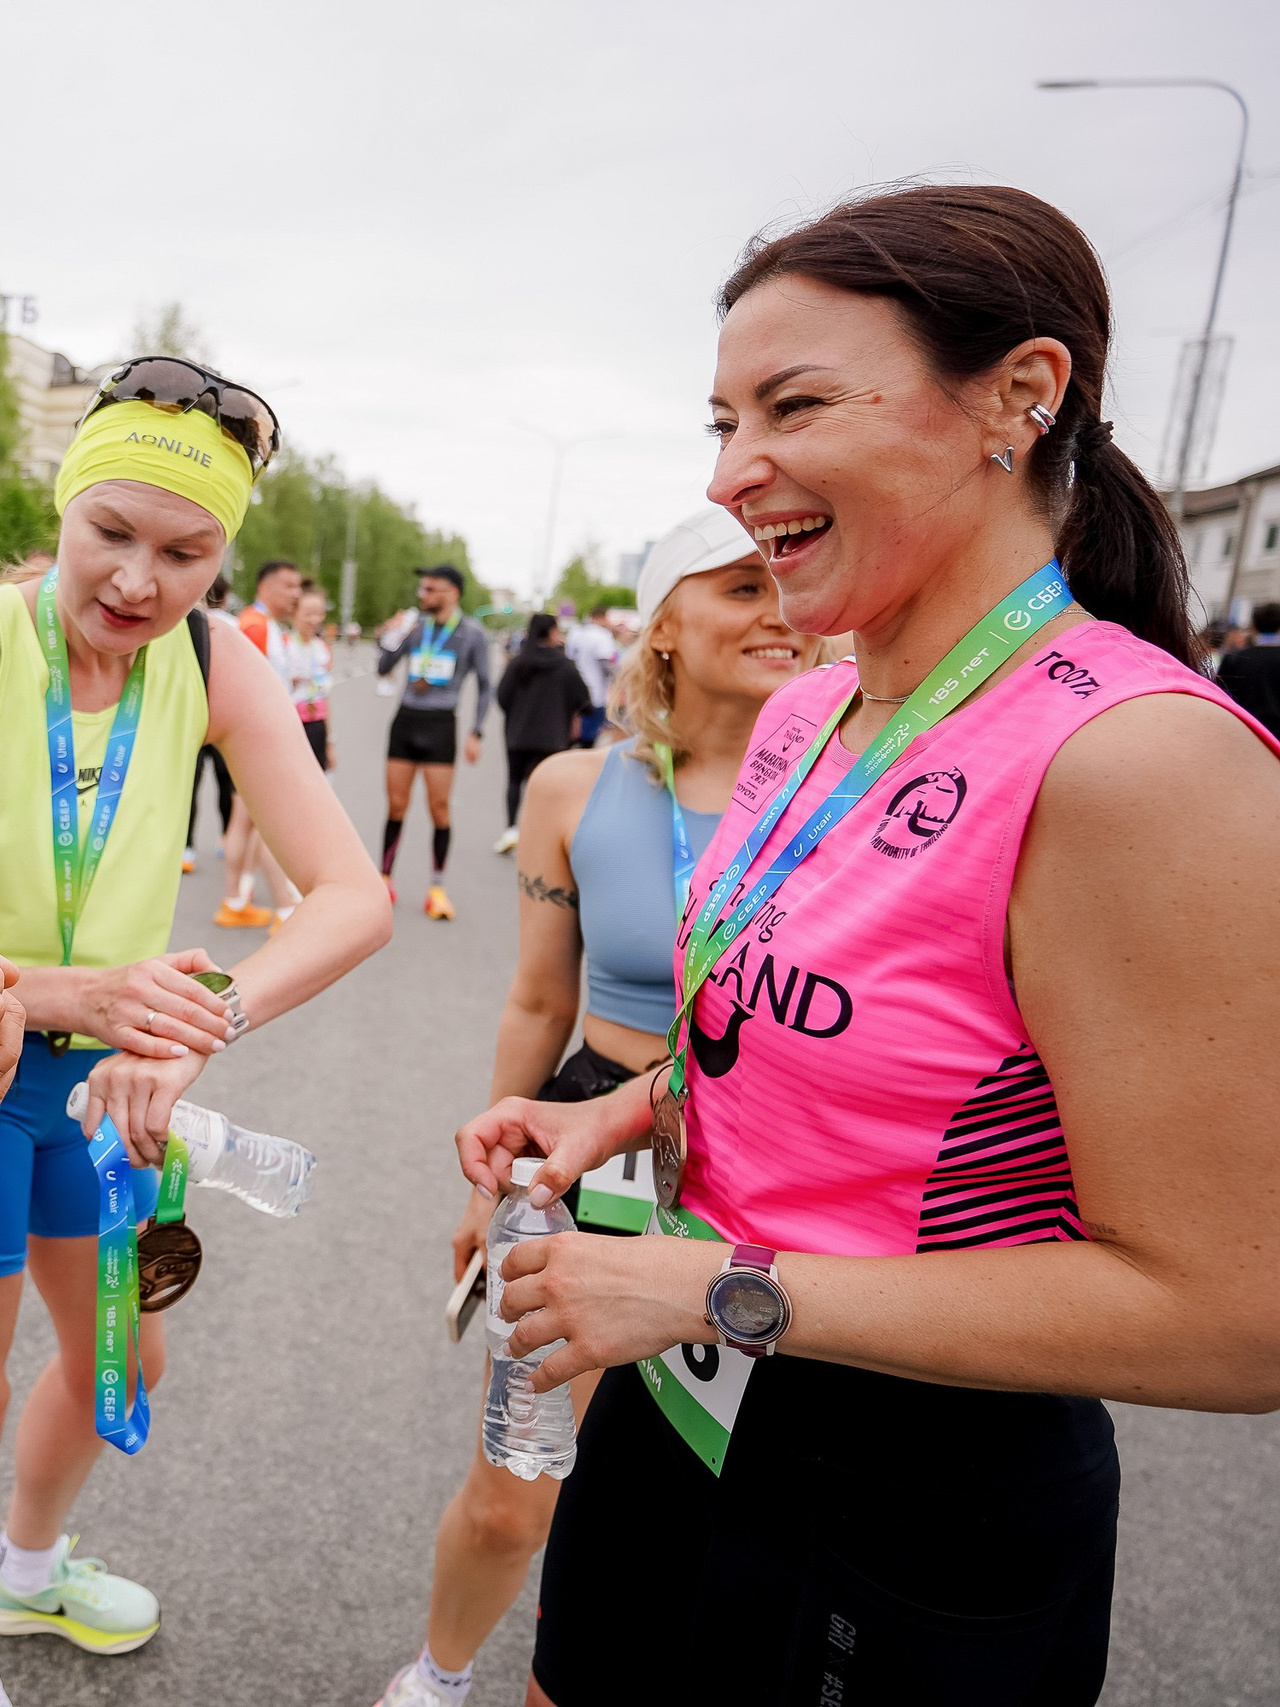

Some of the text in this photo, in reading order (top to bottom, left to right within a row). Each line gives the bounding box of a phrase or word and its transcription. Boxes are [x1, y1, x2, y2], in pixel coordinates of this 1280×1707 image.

[124, 431, 213, 469] AONIJIE
[1026, 580, 1063, 611] СБЕР
[927, 647, 991, 706] 185 лет
[864, 743, 897, 777] марафон
[59, 798, 70, 831] СБЕР
[807, 810, 833, 841] Utair
[703, 883, 727, 922] СБЕР
[737, 884, 767, 922] СБЕР
[105, 1304, 116, 1353] 185 лет
[103, 1386, 116, 1422] СБЕР
